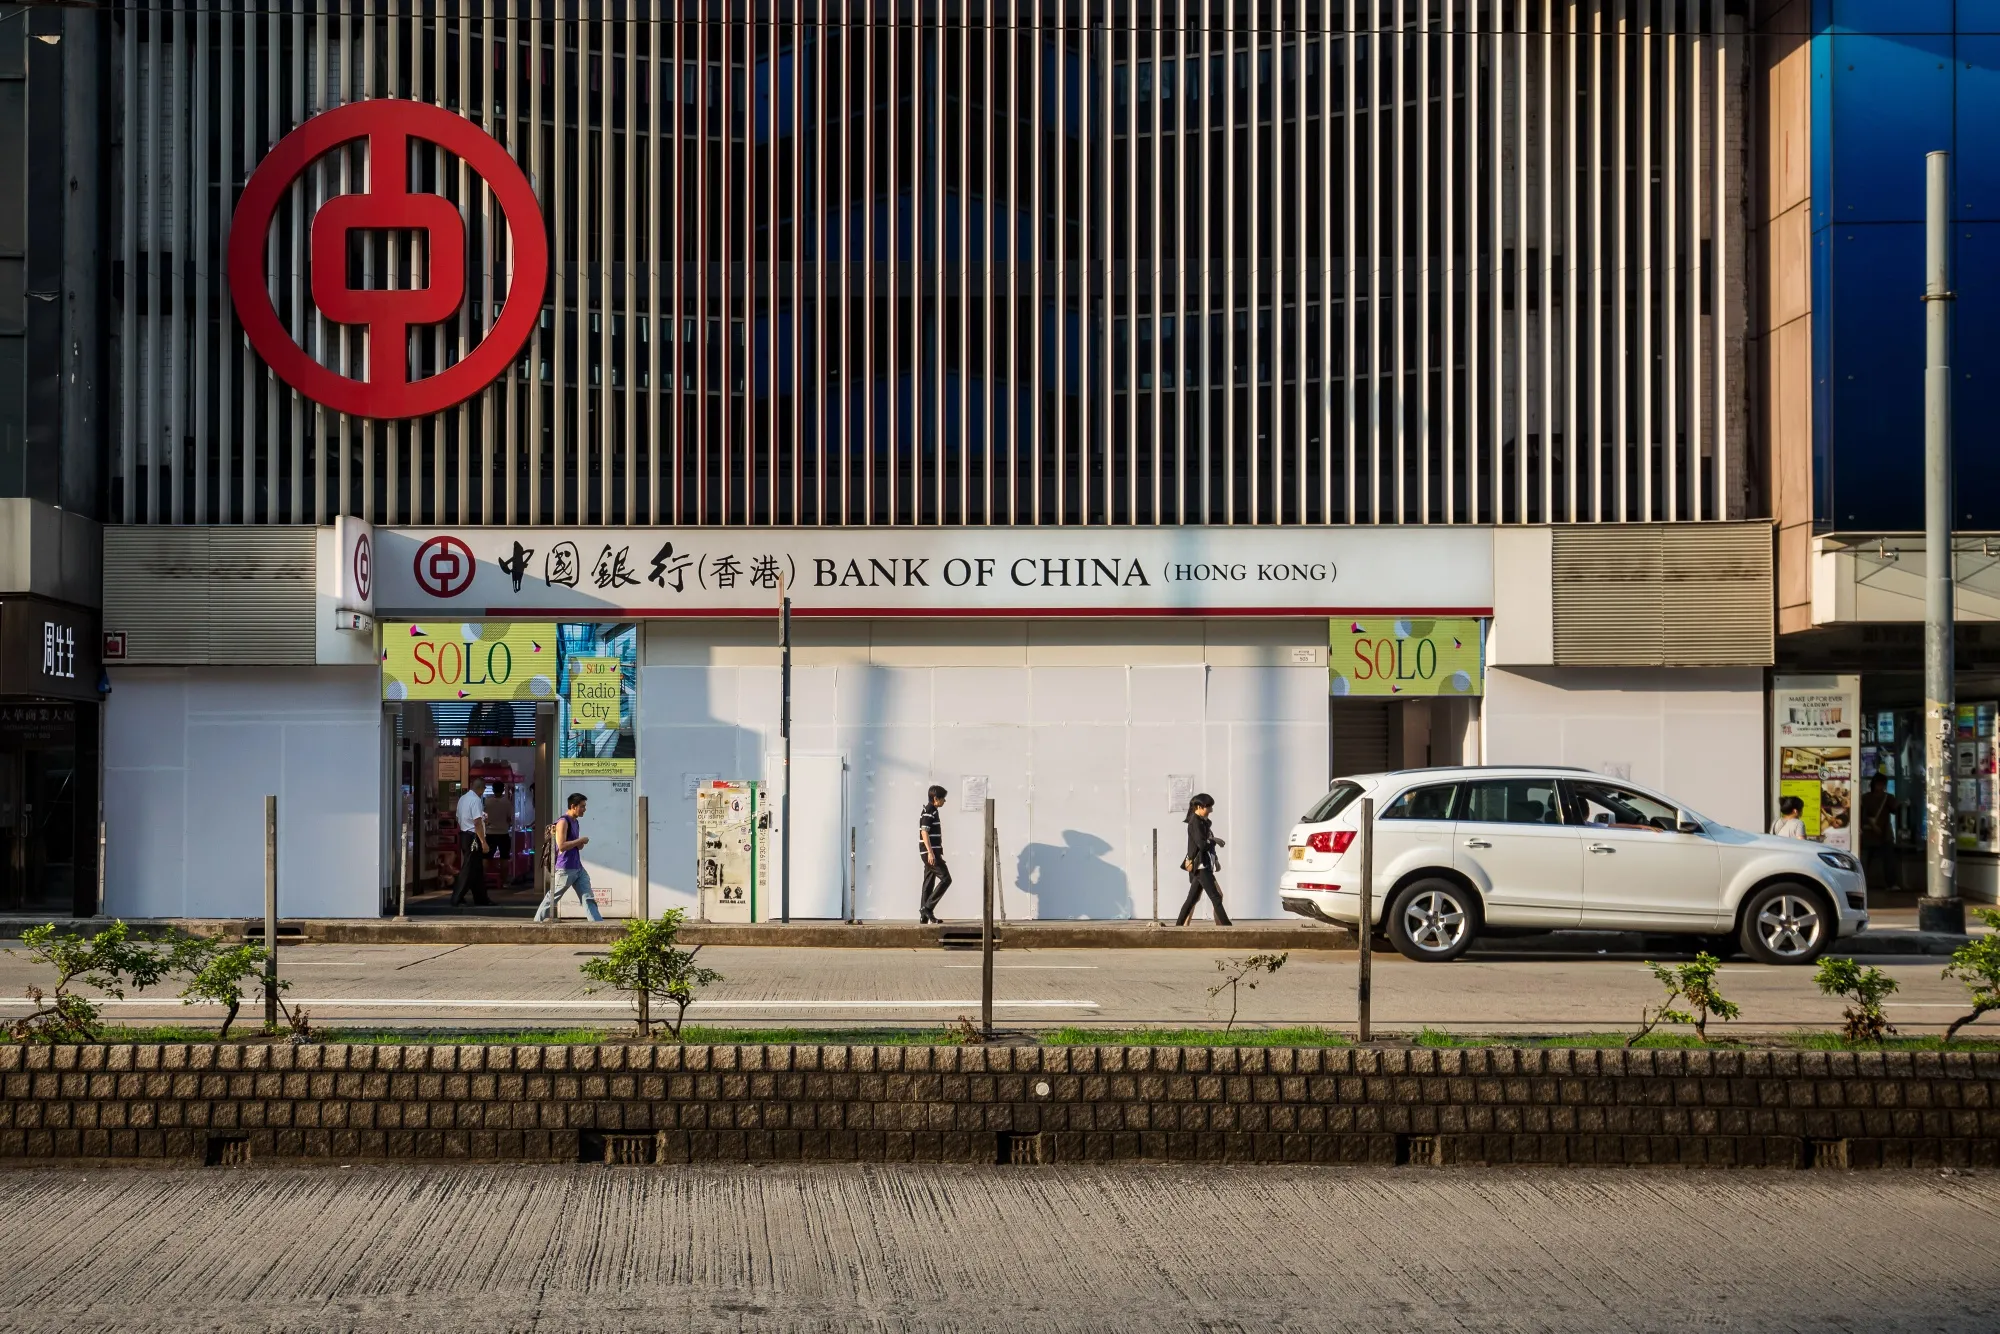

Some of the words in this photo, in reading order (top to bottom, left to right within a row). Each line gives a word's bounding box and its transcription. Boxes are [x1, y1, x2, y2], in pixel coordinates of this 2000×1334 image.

[813, 558, 930, 587] BANK
[943, 558, 996, 587] OF
[1010, 558, 1151, 587] CHINA
[1164, 562, 1247, 583] (HONG
[1257, 562, 1337, 583] KONG)
[43, 622, 74, 678] 周生生
[413, 641, 512, 685] SOLO
[1354, 638, 1437, 680] SOLO
[586, 663, 606, 674] SOLO
[576, 682, 616, 699] Radio
[581, 702, 611, 721] City
